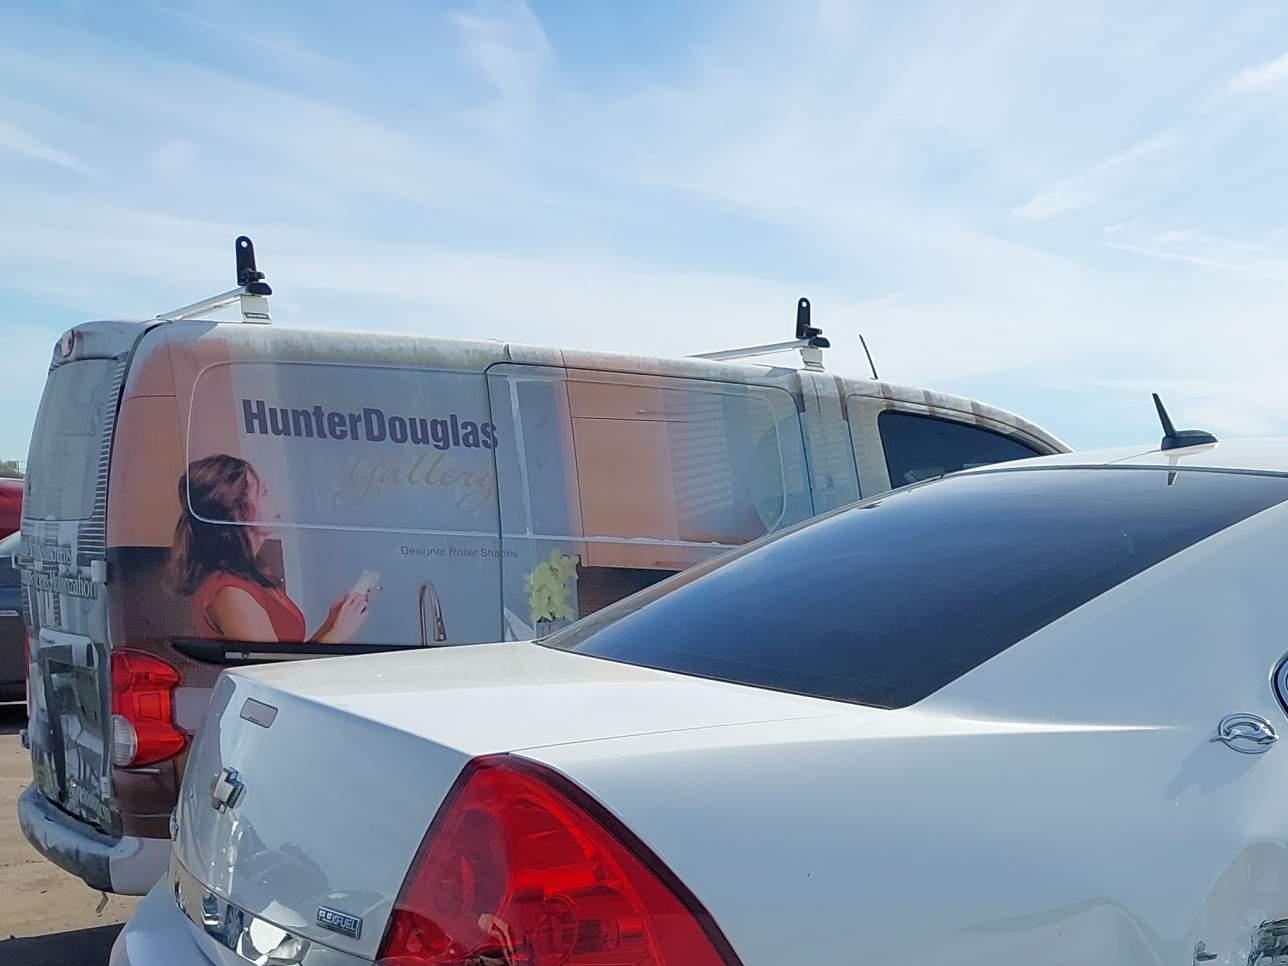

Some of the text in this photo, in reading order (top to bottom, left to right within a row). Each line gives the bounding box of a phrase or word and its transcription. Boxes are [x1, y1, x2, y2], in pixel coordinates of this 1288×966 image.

[242, 399, 499, 450] HunterDouglas
[401, 546, 446, 558] Designer
[449, 547, 478, 558] Roller
